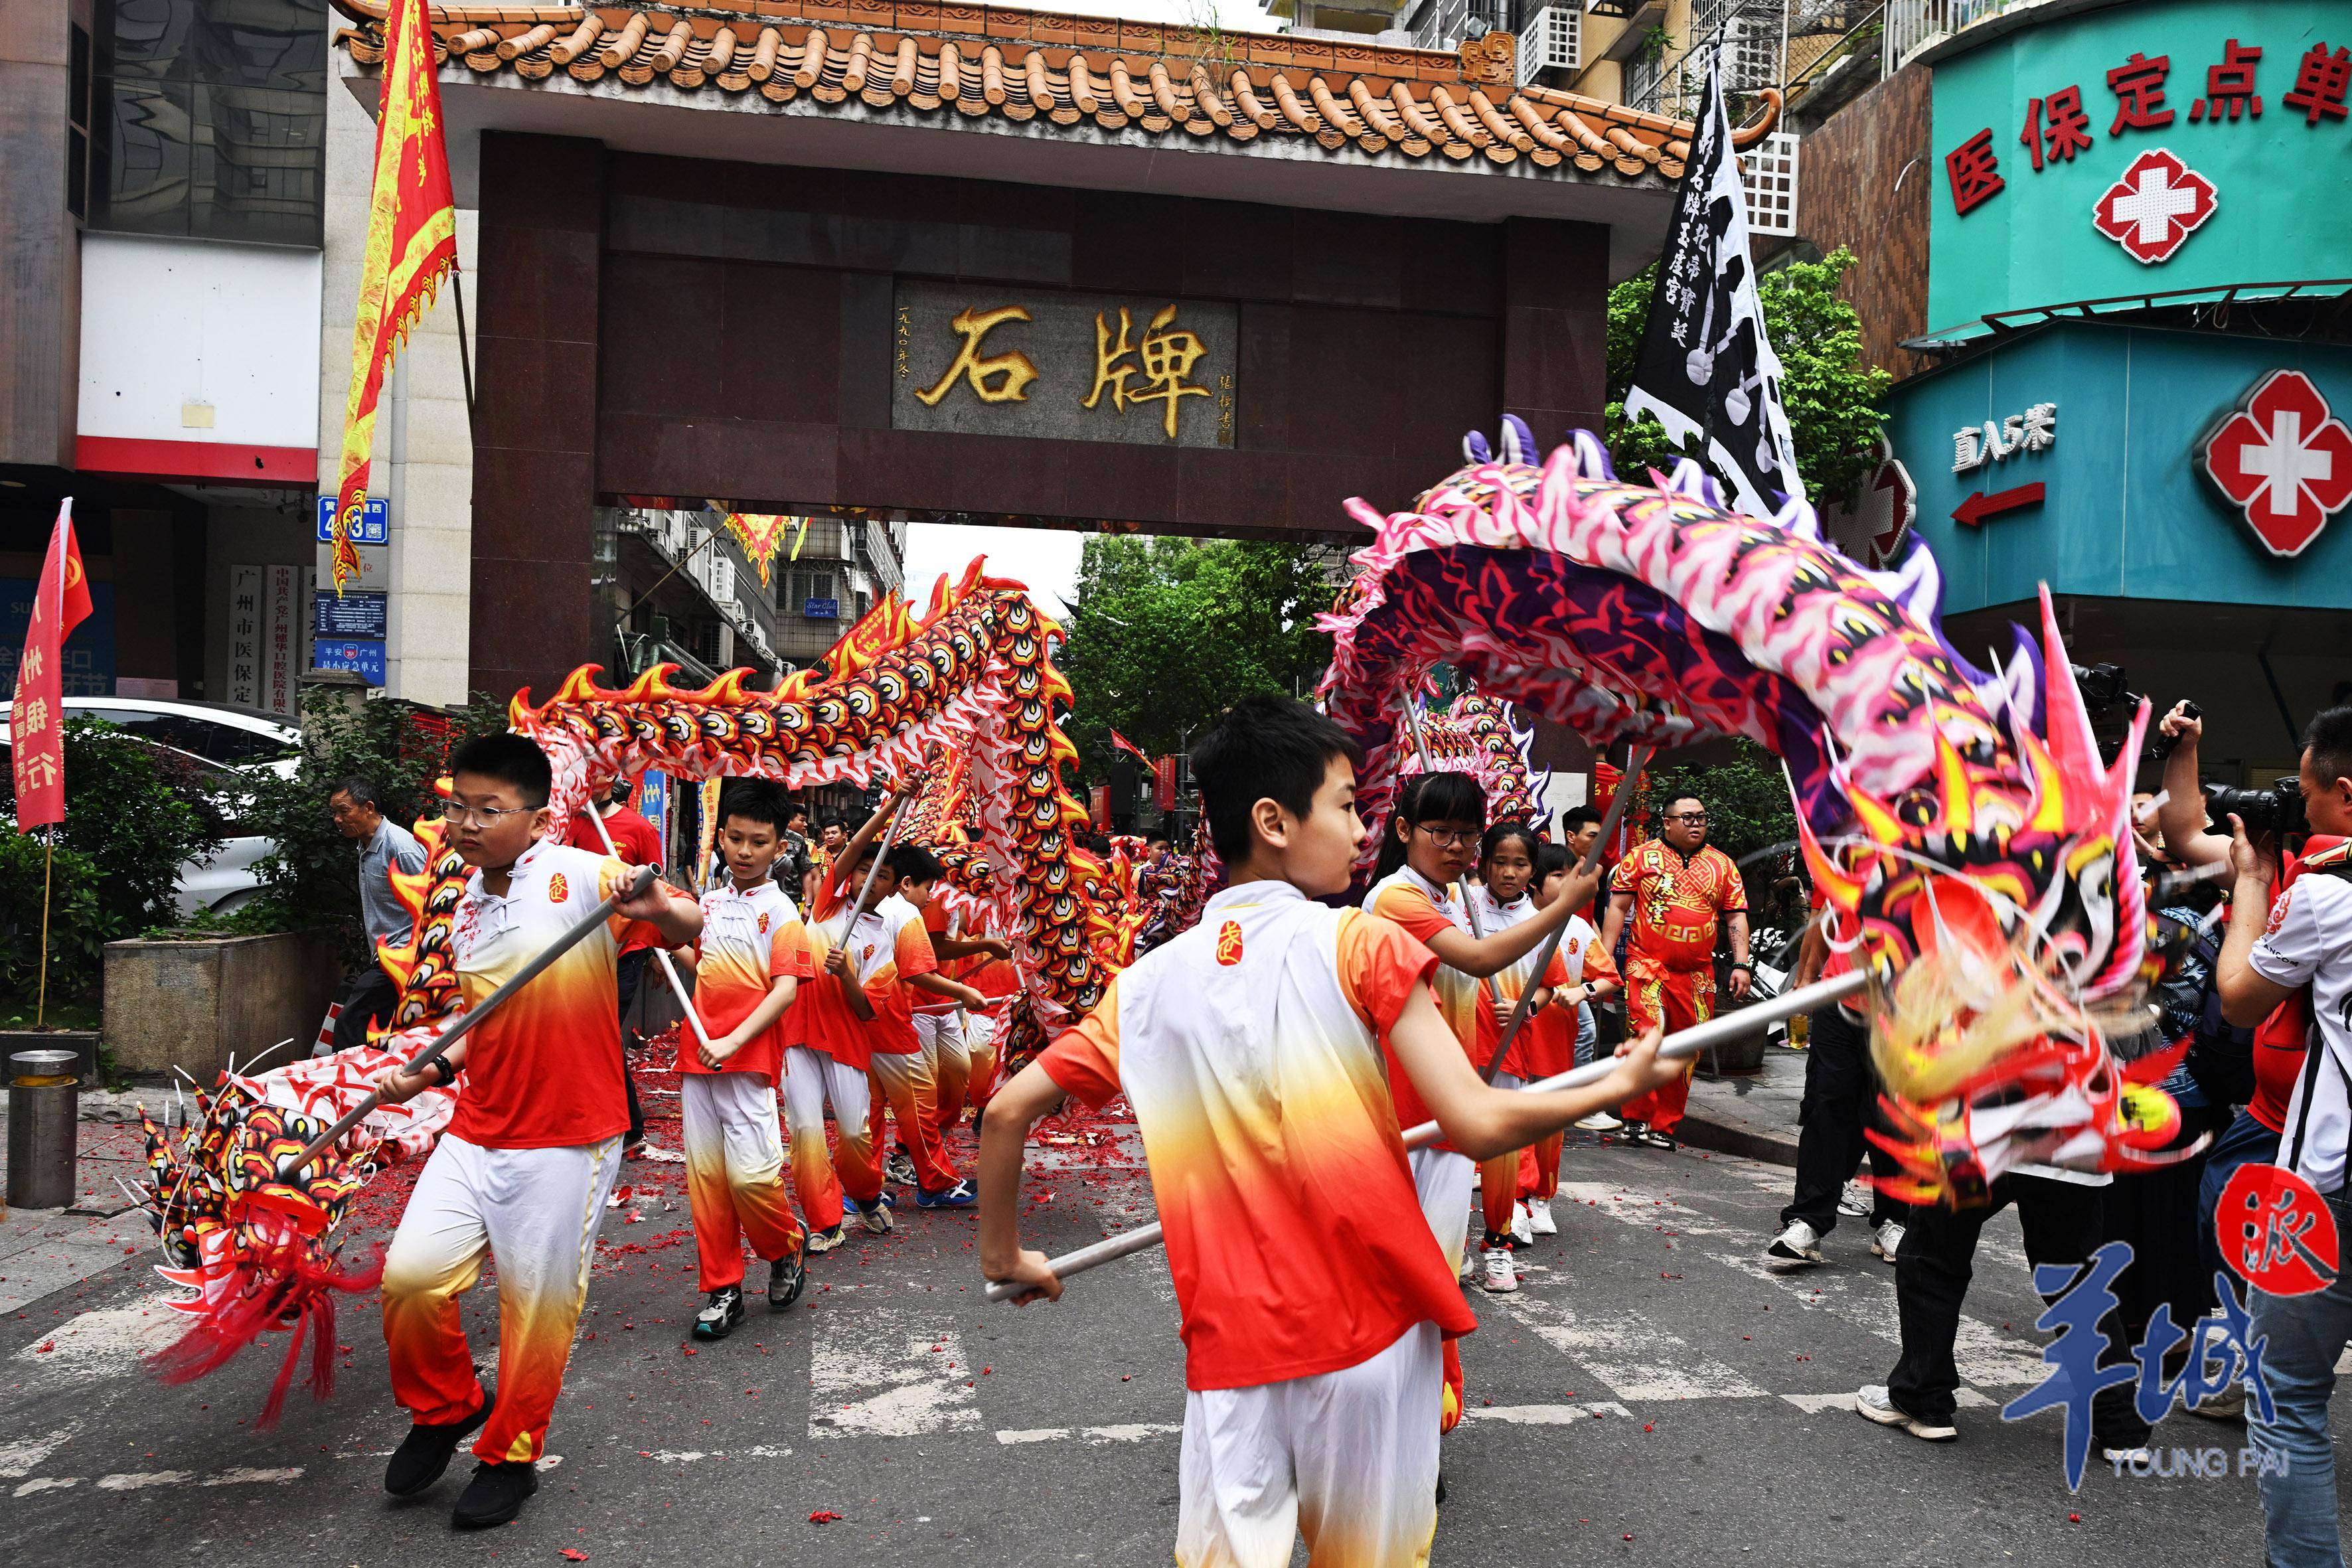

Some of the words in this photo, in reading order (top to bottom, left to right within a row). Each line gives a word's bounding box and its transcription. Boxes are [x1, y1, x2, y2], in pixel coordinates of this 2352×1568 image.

[1945, 39, 2352, 216] 医保定点单
[914, 303, 1214, 439] 石牌
[1951, 403, 2057, 473] 直入5米
[325, 514, 363, 538] 43
[325, 647, 343, 657] 平安
[359, 648, 377, 657] 广州
[323, 660, 379, 672] 最小应急单元
